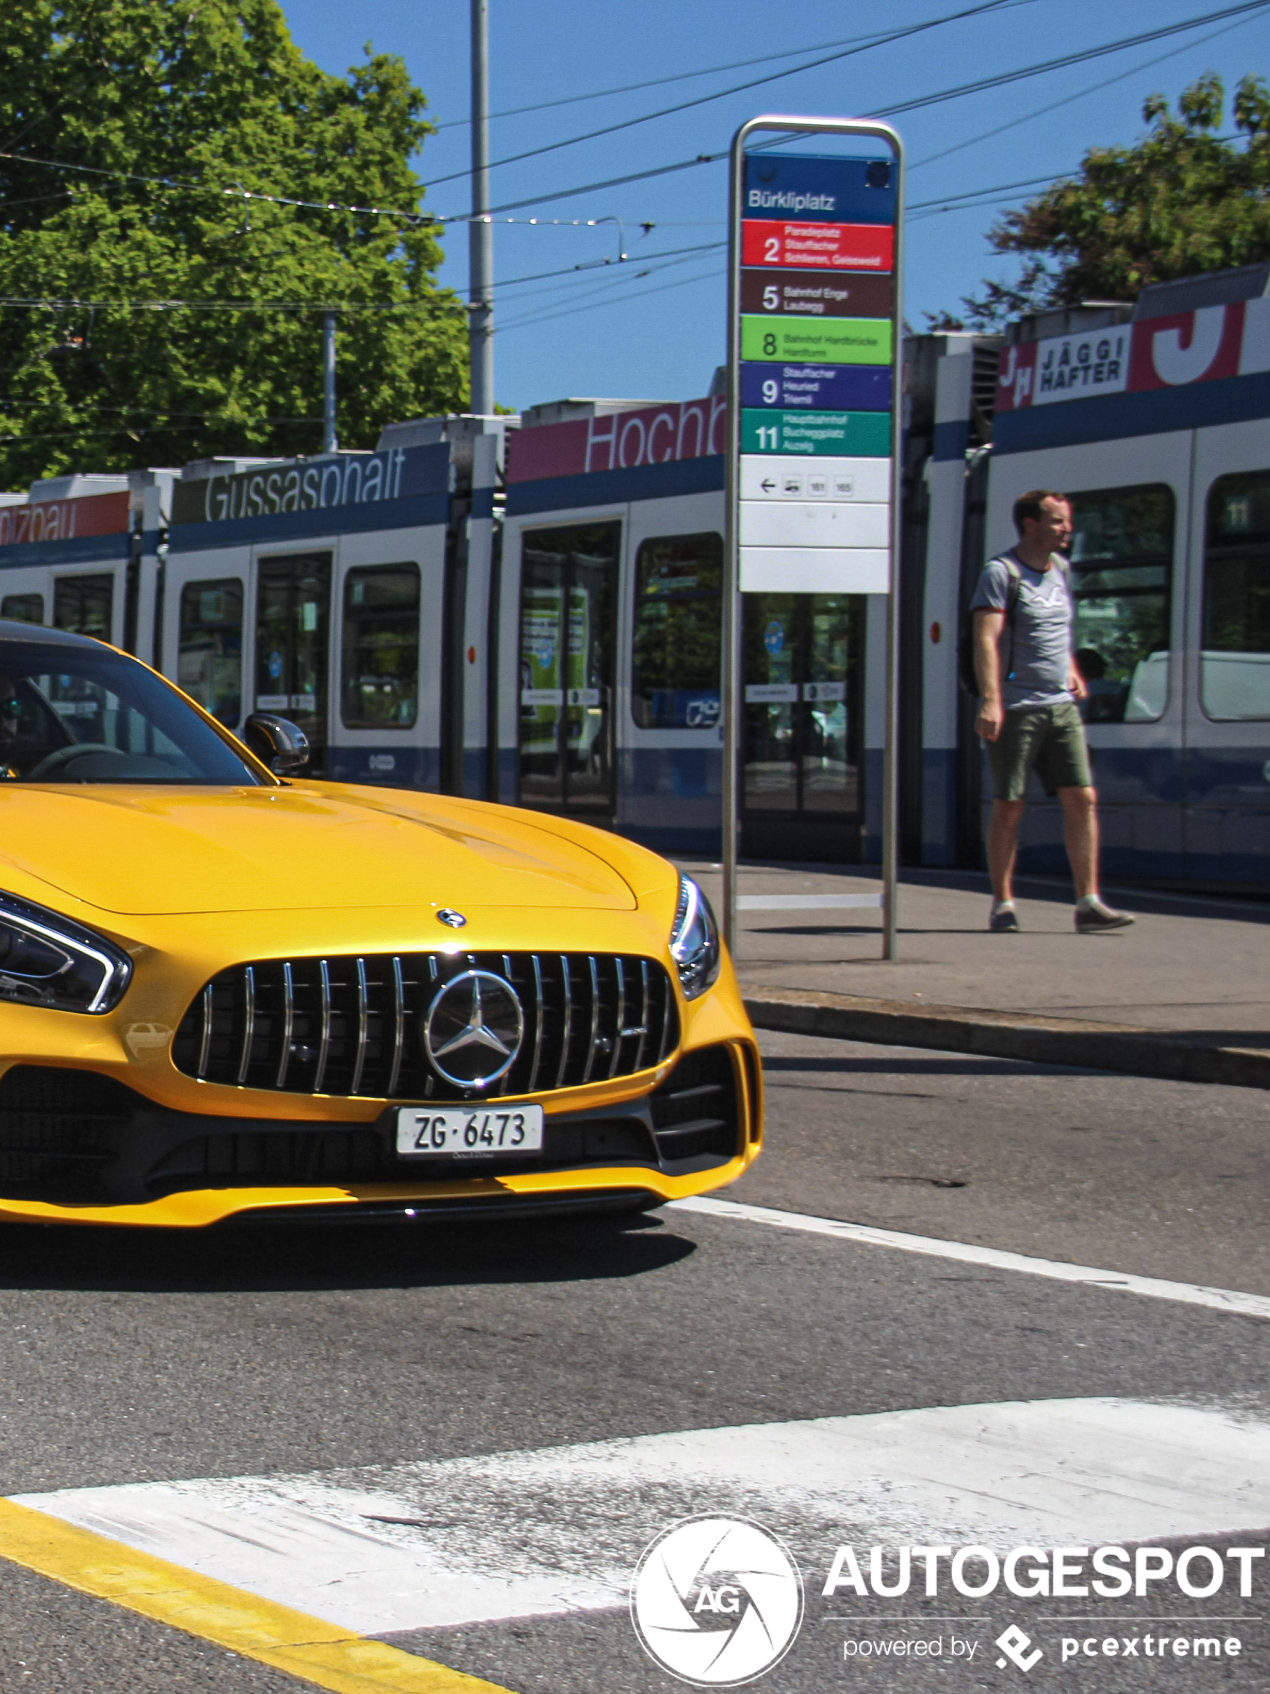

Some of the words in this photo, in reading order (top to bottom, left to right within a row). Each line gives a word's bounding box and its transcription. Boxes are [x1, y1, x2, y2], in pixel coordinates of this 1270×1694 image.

[748, 189, 835, 213] Bürkliplatz
[784, 225, 841, 238] Paradeplatz
[763, 238, 780, 262] 2
[784, 239, 839, 251] Stauffacher
[762, 286, 779, 310] 5
[783, 286, 822, 298] Bahnhof
[824, 287, 849, 301] Enge
[762, 333, 777, 356] 8
[1042, 336, 1124, 370] JÄGGI
[782, 367, 836, 379] Stauffacher
[1039, 360, 1121, 393] HAFTER
[761, 379, 778, 404] 9
[755, 426, 778, 450] 11
[205, 447, 406, 522] Gussasphalt
